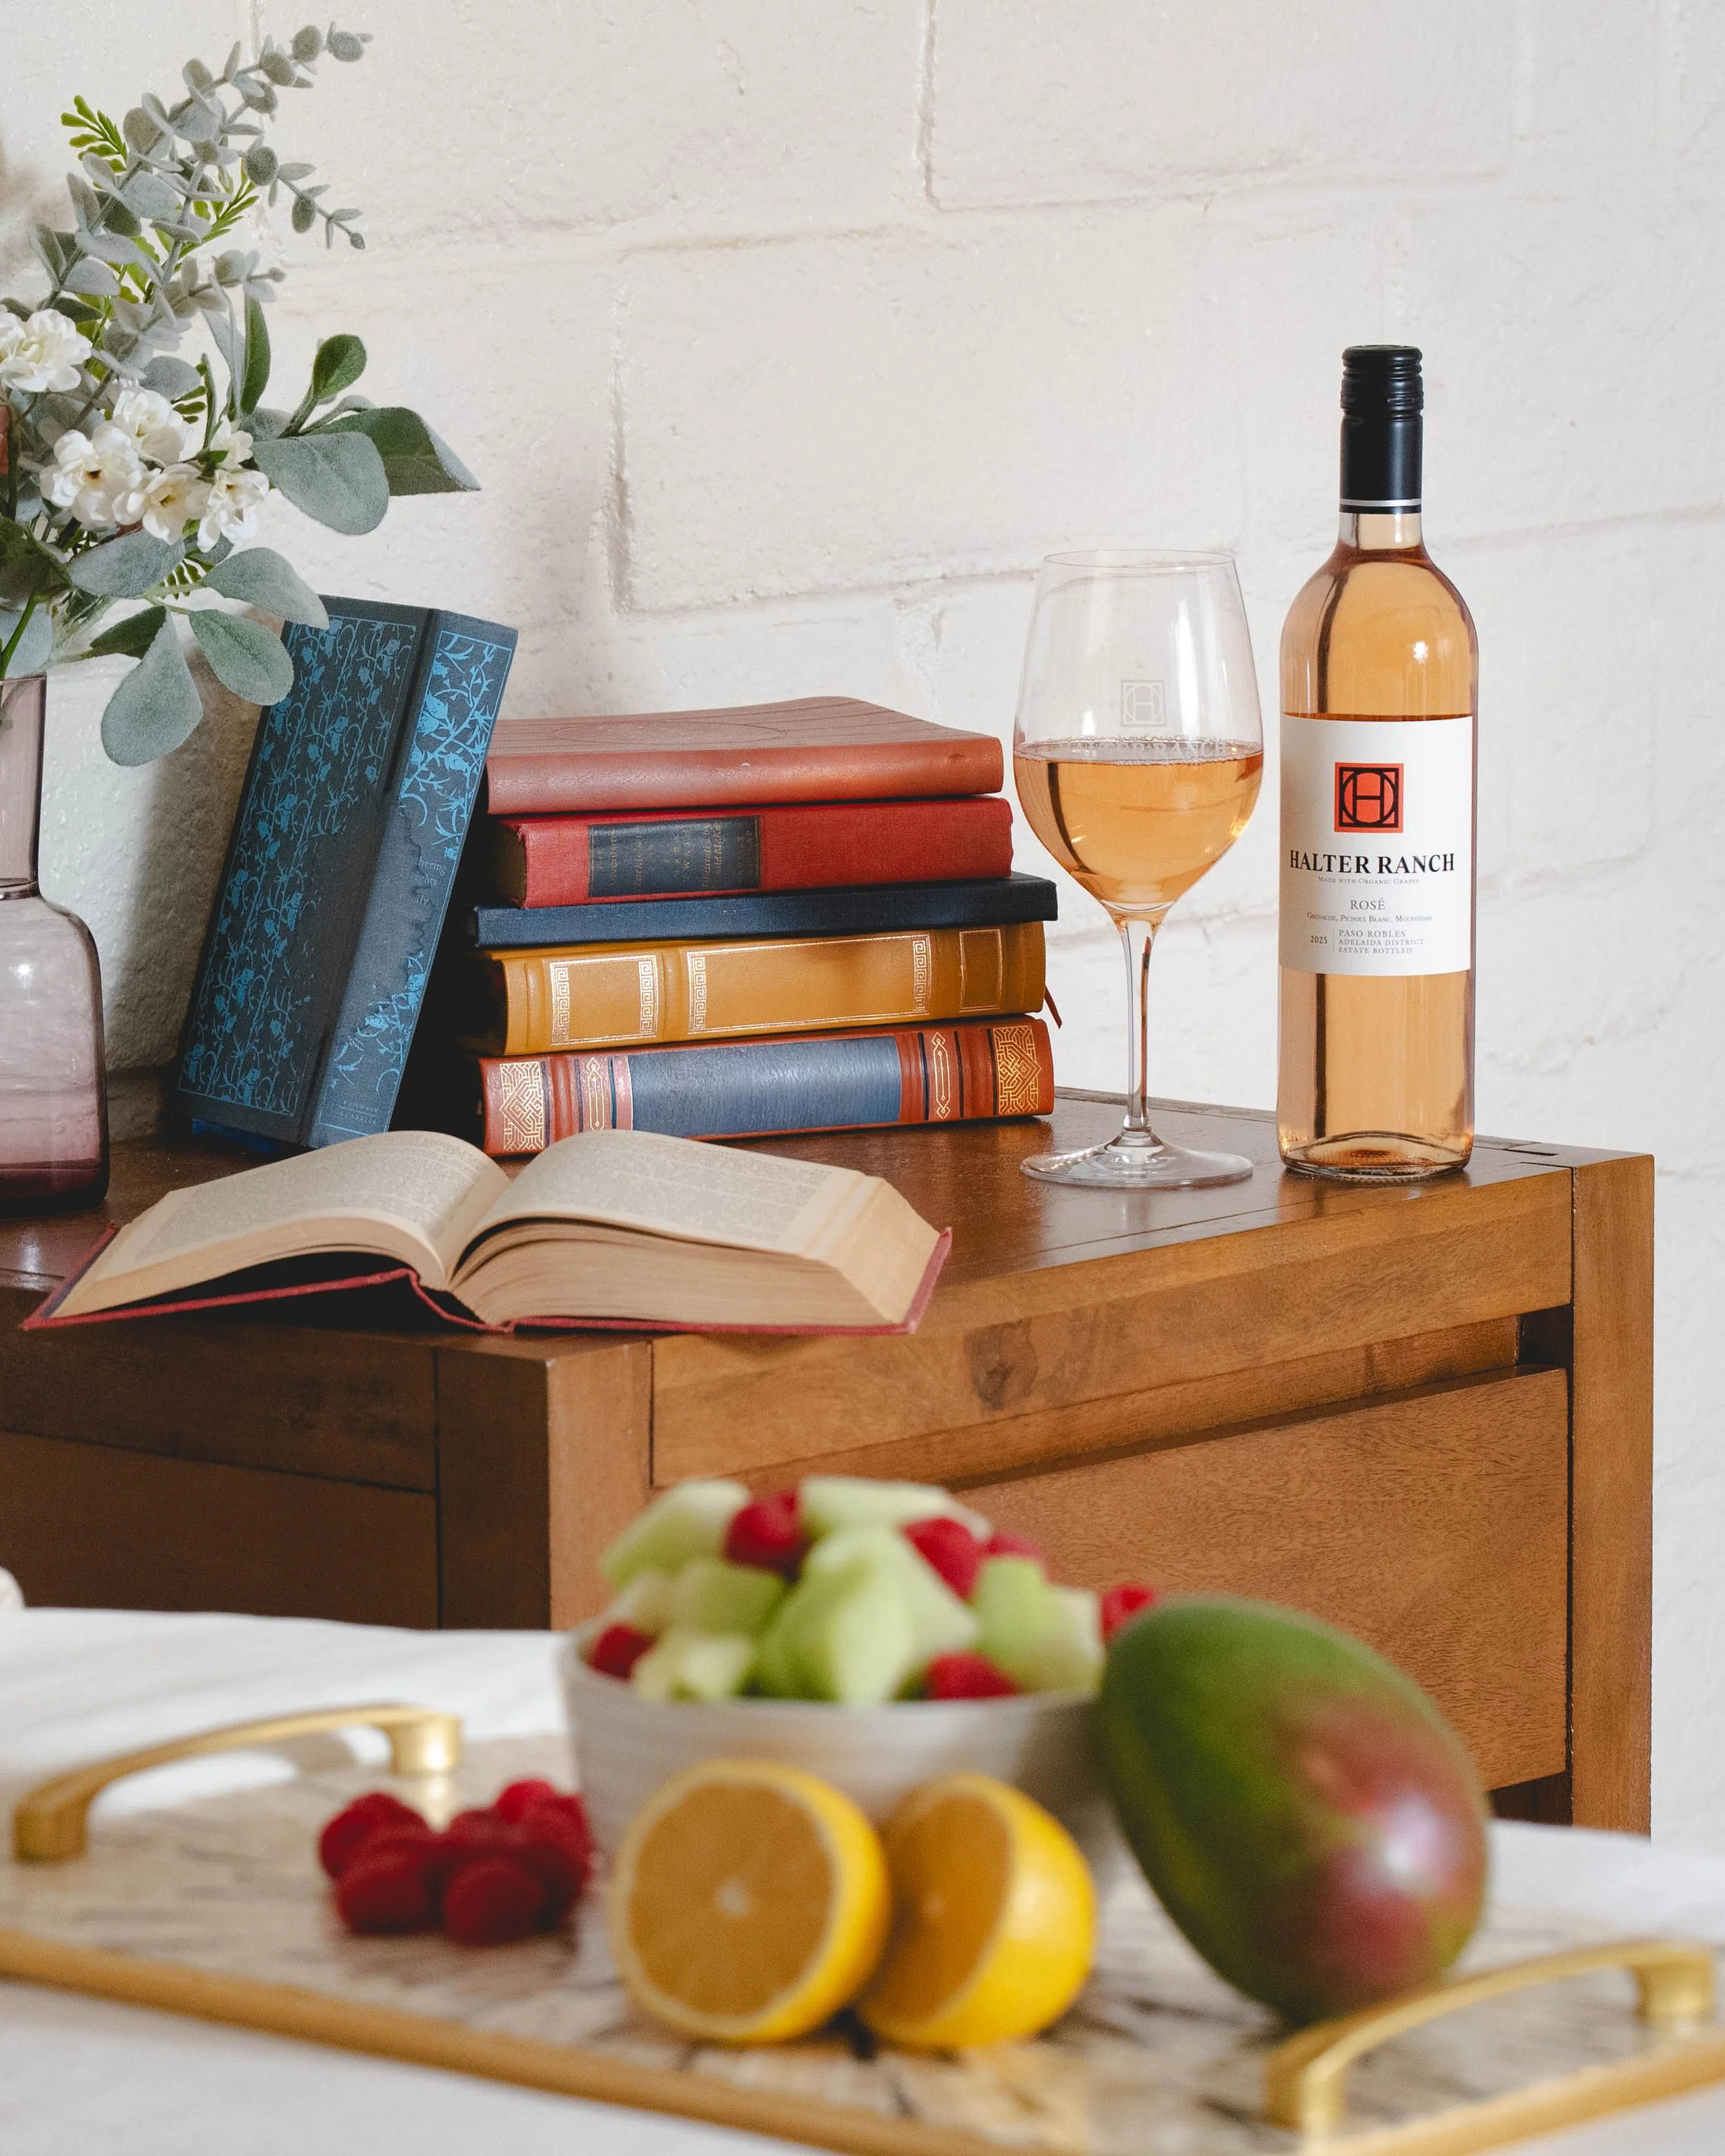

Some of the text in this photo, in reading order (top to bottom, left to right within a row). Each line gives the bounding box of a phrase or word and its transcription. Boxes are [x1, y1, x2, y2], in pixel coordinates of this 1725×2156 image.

[1290, 849, 1455, 874] HALTER RANCH
[1350, 898, 1386, 910] ROSÉ
[1339, 929, 1363, 938] PASO
[1310, 935, 1328, 945] 2025
